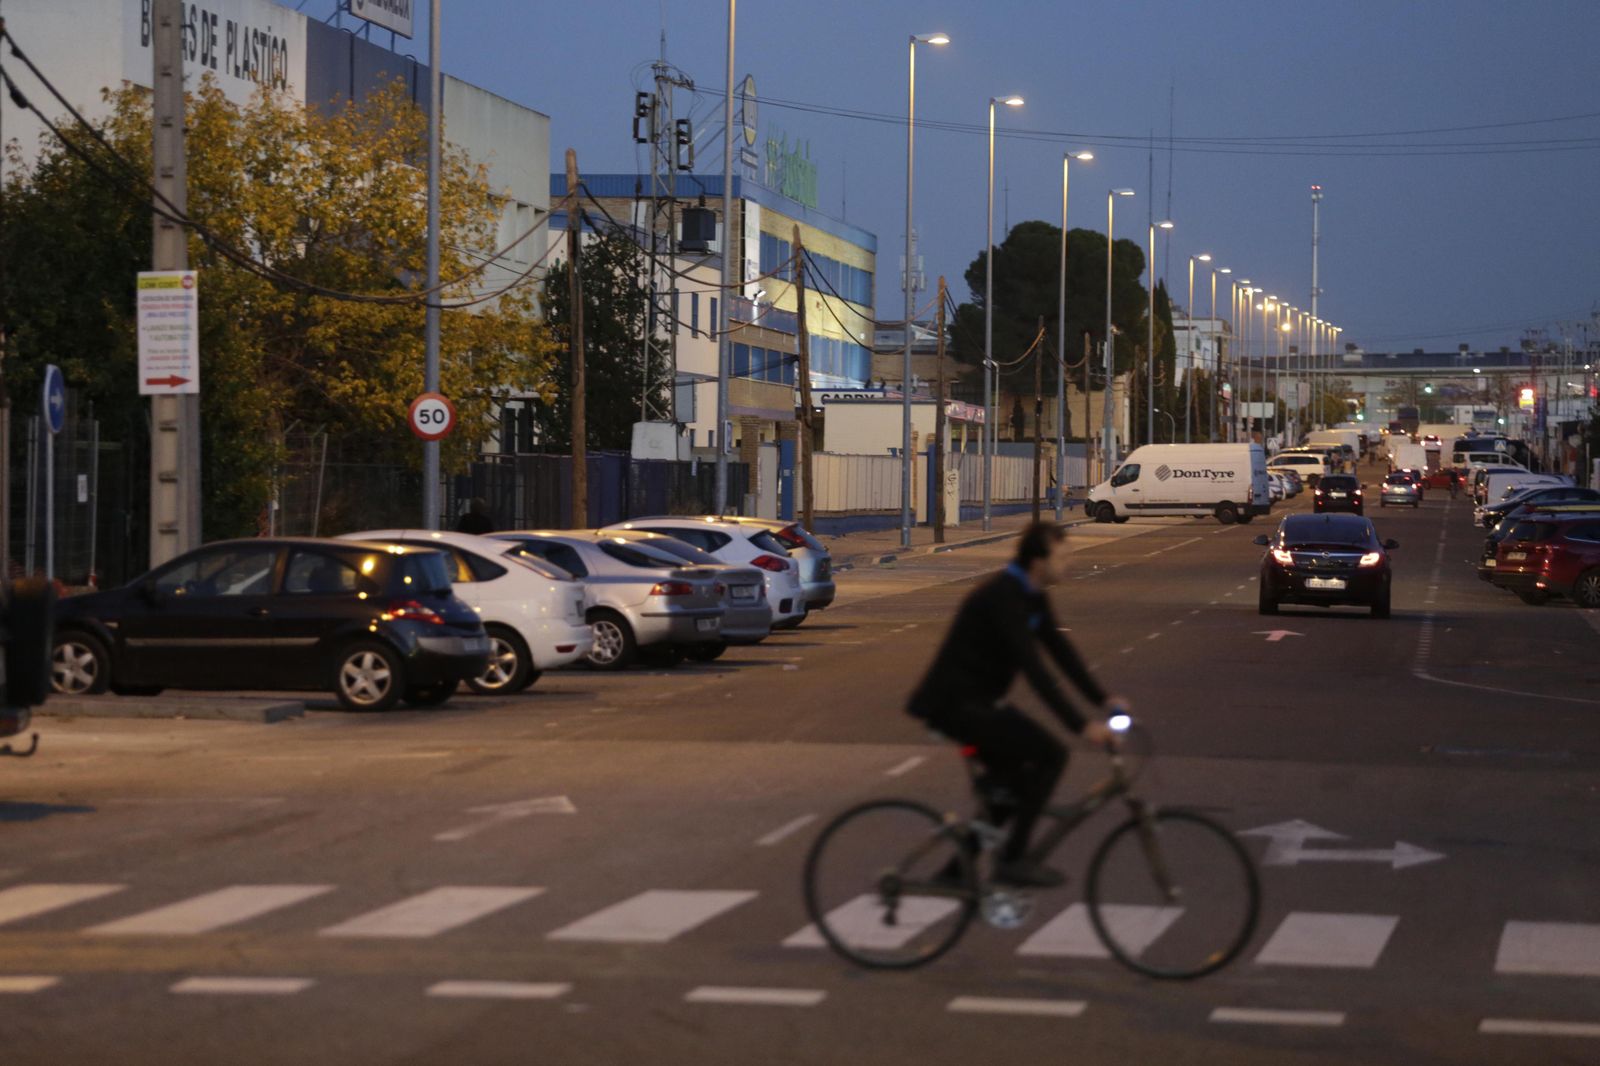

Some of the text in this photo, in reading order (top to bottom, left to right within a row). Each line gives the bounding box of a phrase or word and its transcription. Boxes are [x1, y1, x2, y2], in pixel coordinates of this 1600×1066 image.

[201, 9, 217, 69] DE
[420, 408, 445, 424] 50
[1173, 469, 1234, 480] DonTyre
